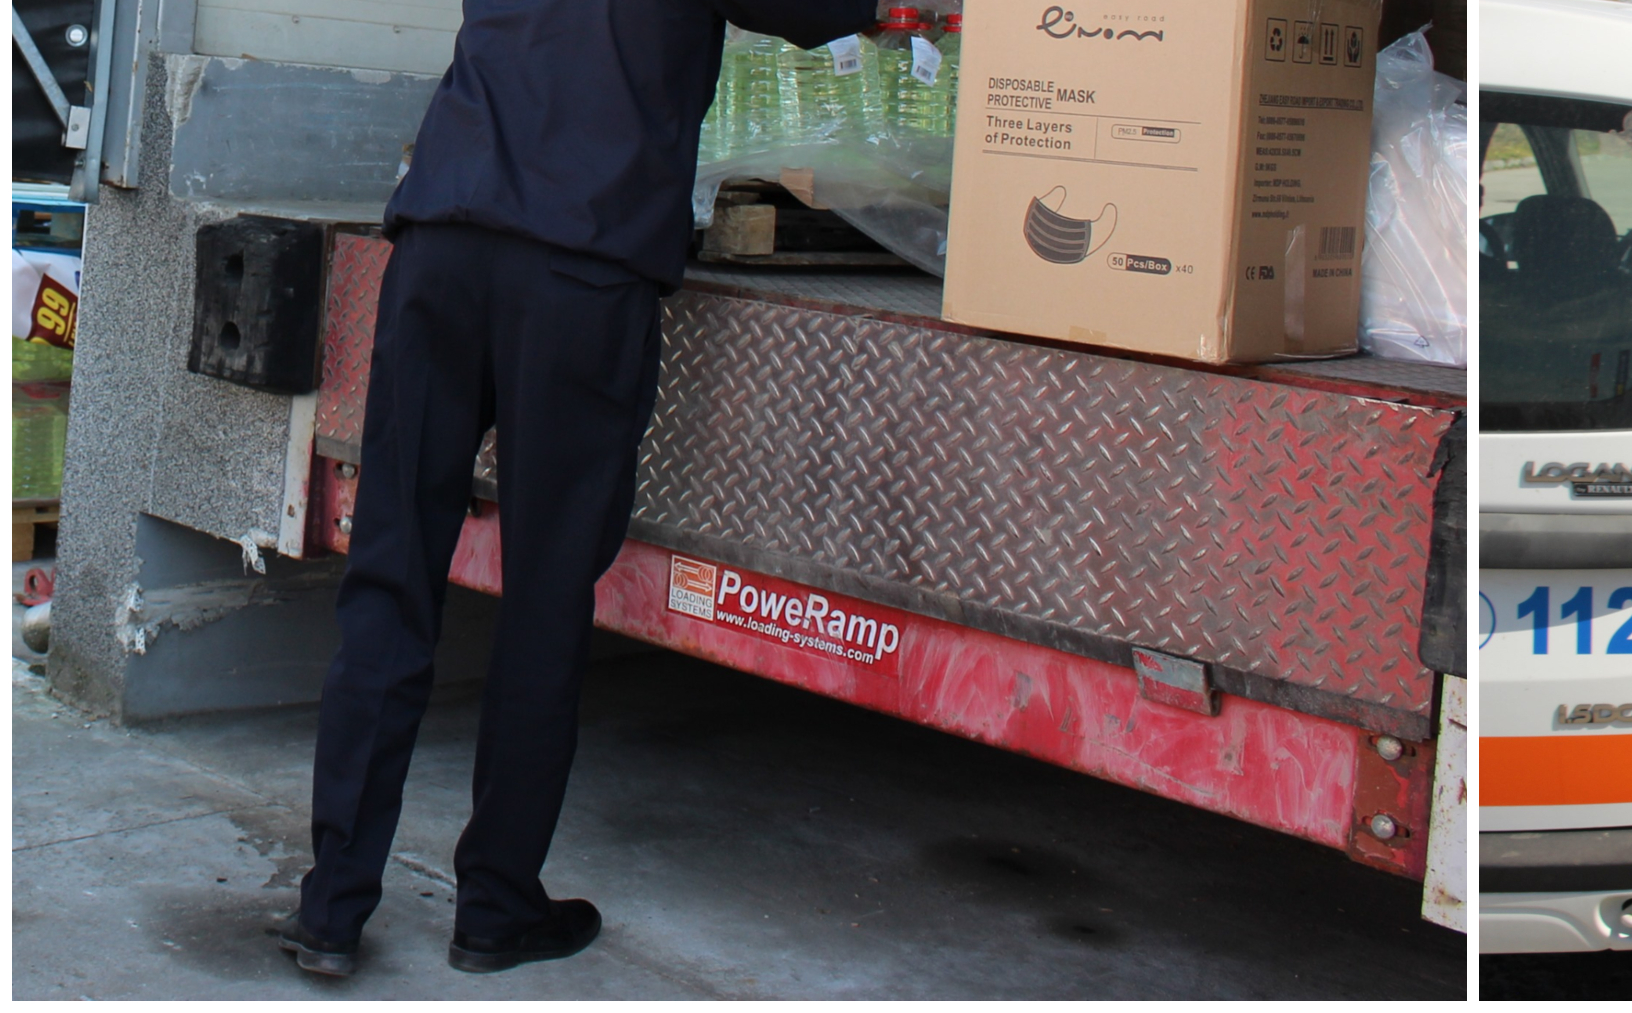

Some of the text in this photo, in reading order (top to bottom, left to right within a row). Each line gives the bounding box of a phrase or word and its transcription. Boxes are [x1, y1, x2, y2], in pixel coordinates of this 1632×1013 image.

[1103, 14, 1165, 23] easy road
[988, 77, 1055, 93] DISPOSABLE
[987, 88, 1096, 109] PROTECTIVE MASK
[986, 115, 1073, 134] Three Layers
[1117, 127, 1174, 137] PM2.5 Protection
[985, 132, 1072, 151] of Protection
[1111, 256, 1194, 275] 50 Pcs/Box x40
[1312, 268, 1329, 278] MADE
[671, 588, 713, 609] LOADING
[670, 598, 713, 619] SYSTEMS
[717, 569, 900, 661] PoweRamp
[716, 609, 875, 665] www.loading-systems.com
